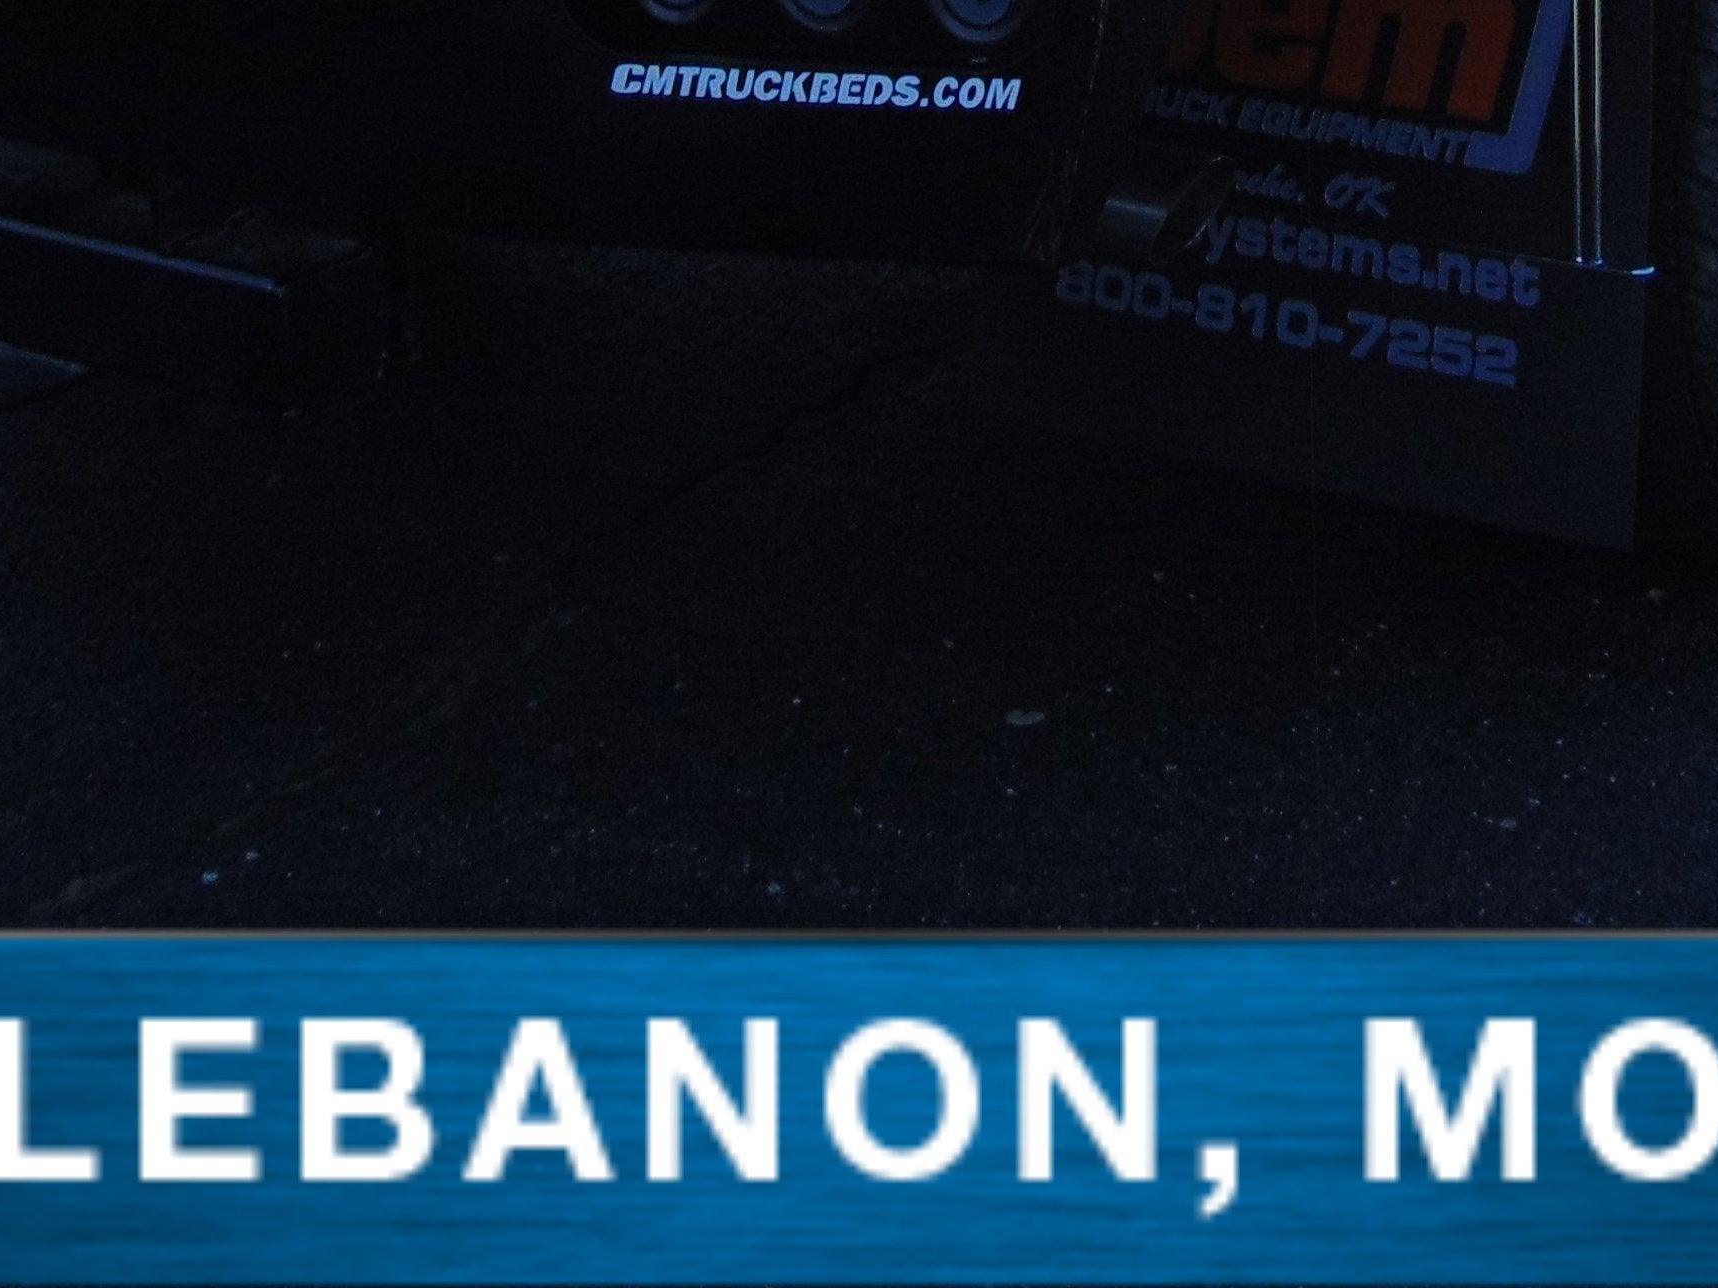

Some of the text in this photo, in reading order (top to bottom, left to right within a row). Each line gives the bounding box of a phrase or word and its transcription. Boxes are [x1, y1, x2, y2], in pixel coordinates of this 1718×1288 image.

[610, 63, 1022, 111] CMTRUCKBEDS.COM
[1238, 96, 1471, 166] EQUIPMENT
[1203, 212, 1542, 308] ystems.net
